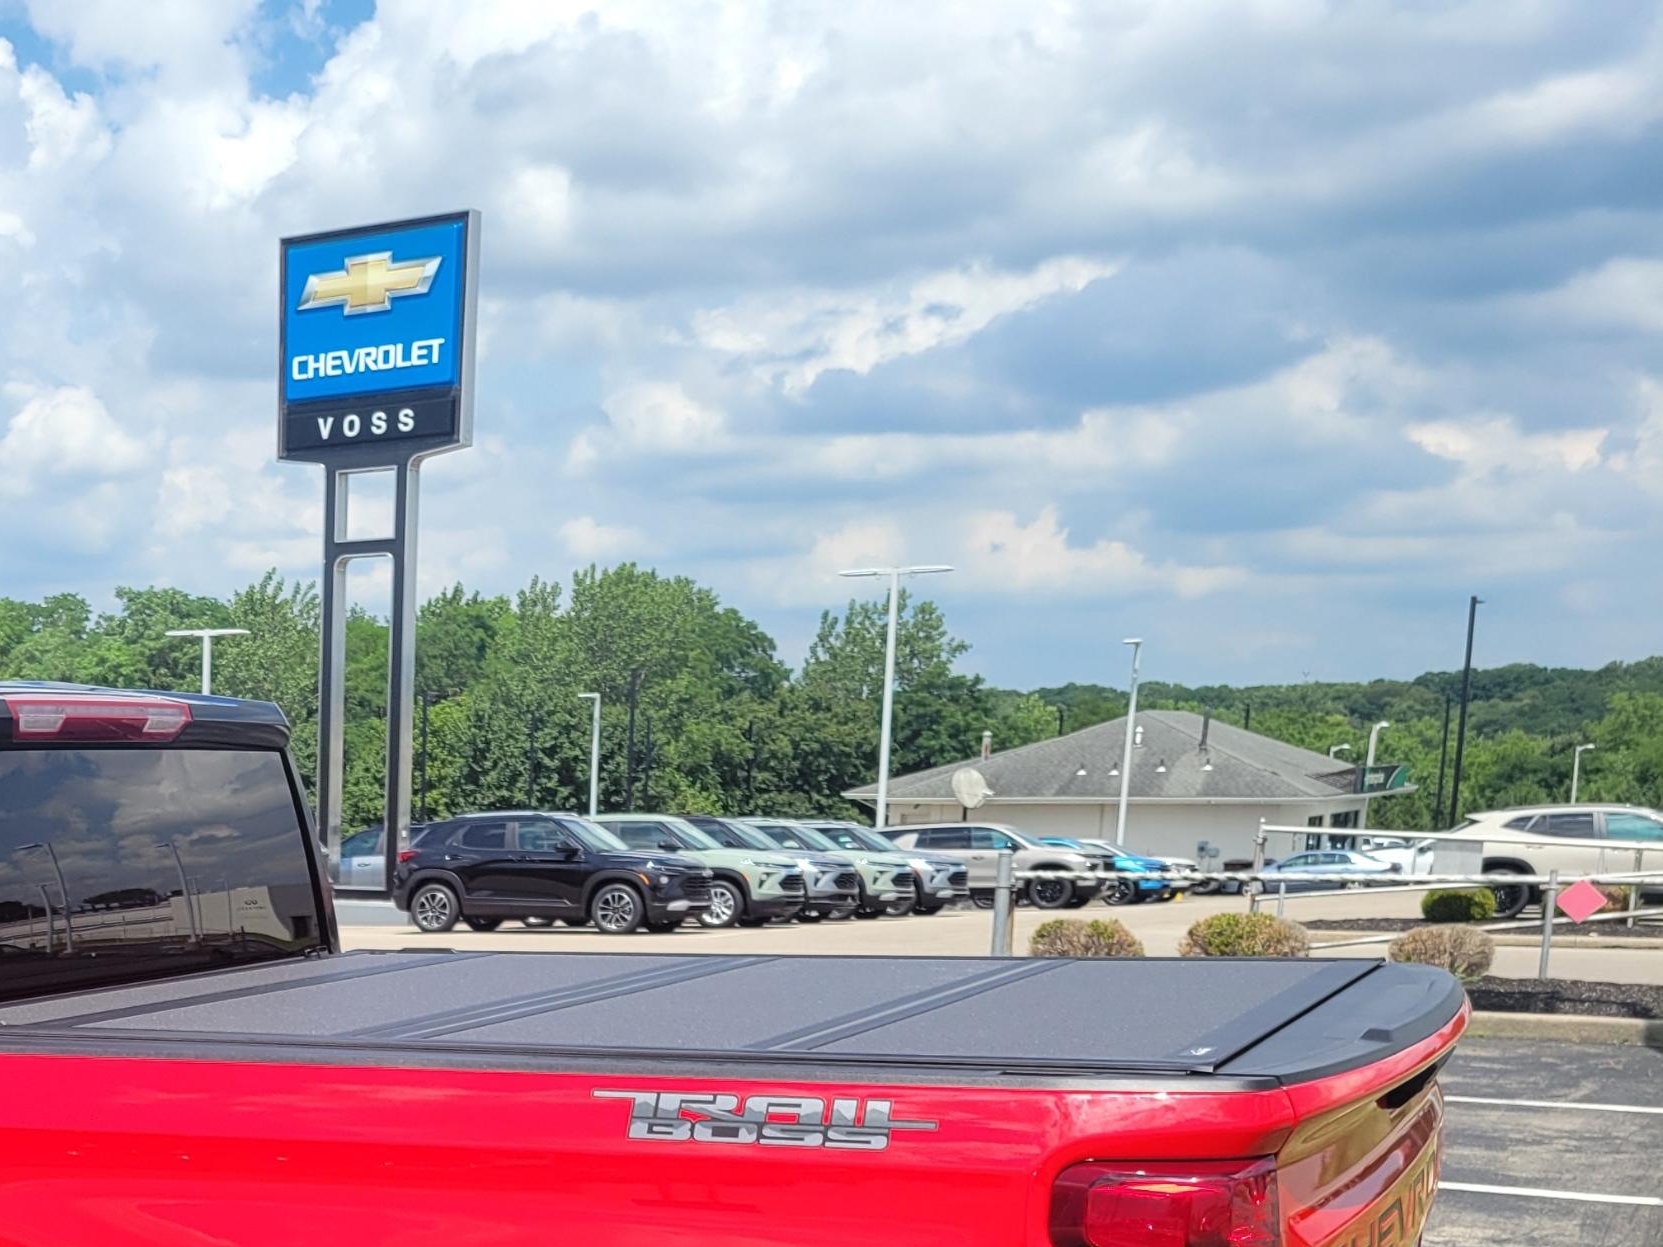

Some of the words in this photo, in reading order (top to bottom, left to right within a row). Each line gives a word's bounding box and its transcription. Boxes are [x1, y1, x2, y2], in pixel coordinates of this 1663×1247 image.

[291, 338, 445, 380] CHEVROLET
[317, 408, 415, 440] VOSS
[591, 1088, 938, 1129] TRAIL
[628, 1119, 889, 1150] BOSS
